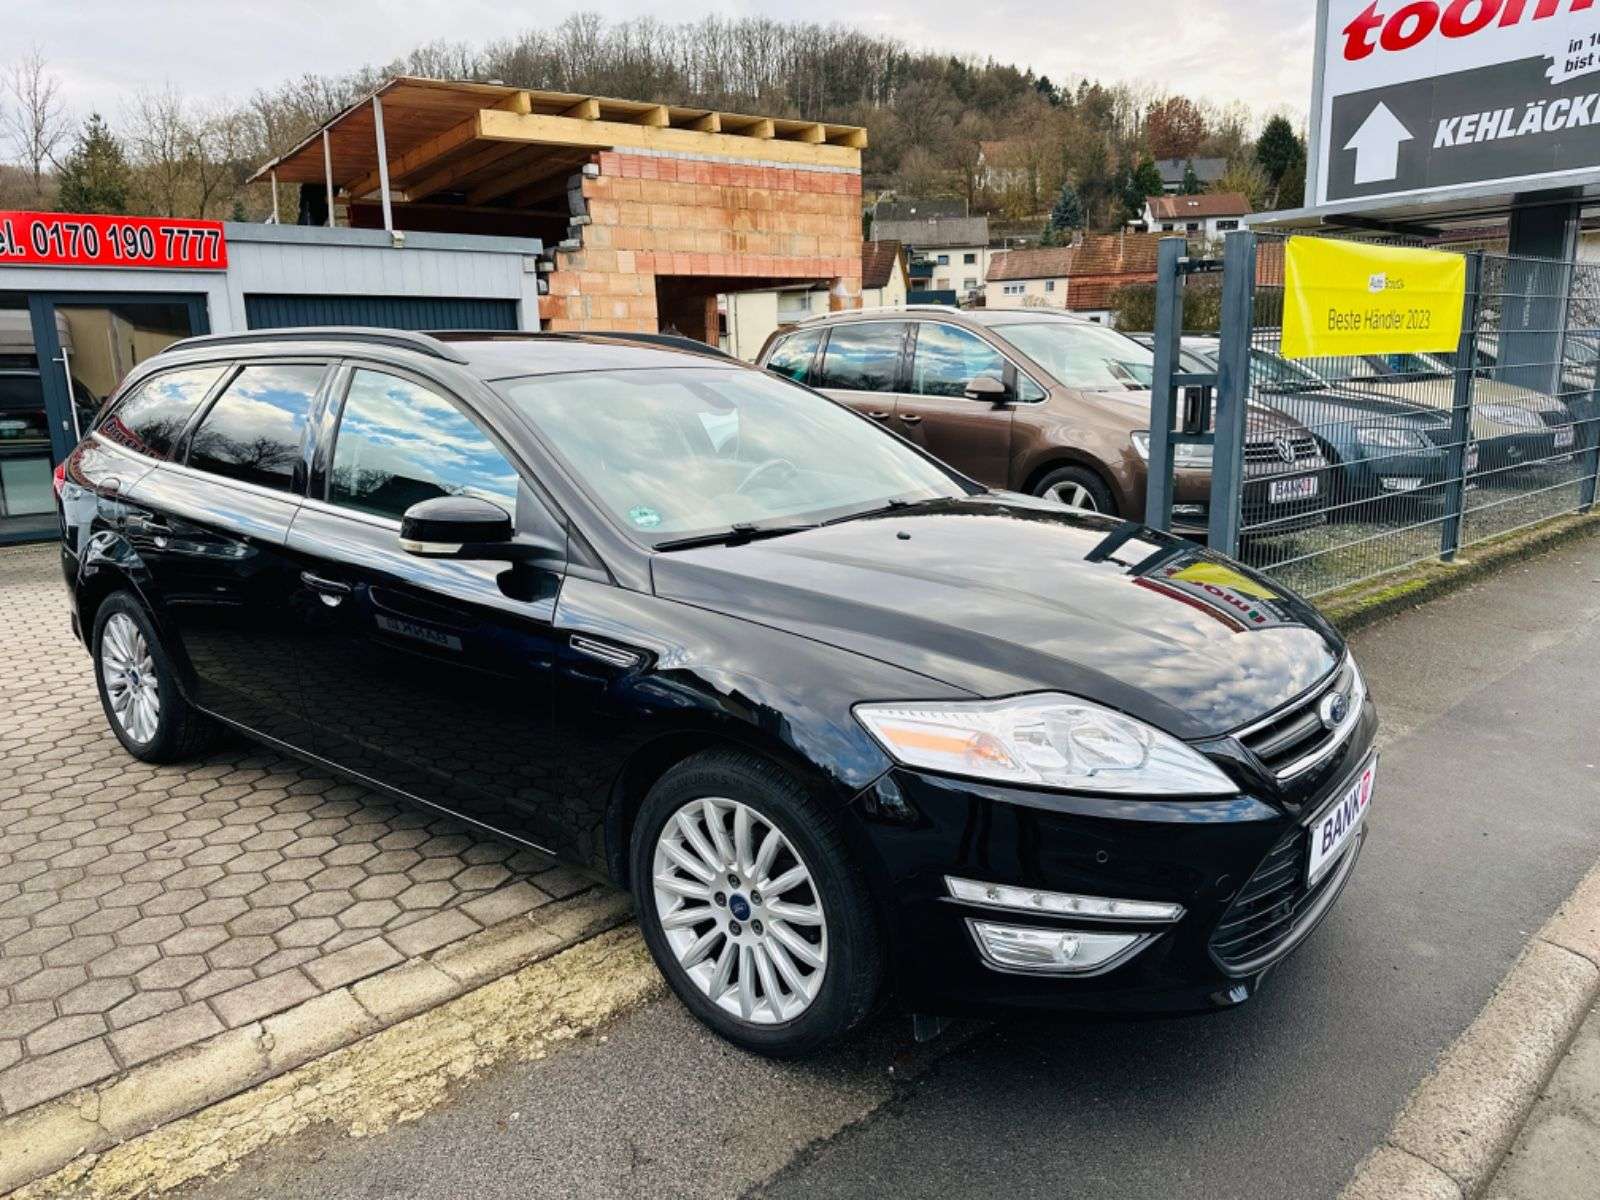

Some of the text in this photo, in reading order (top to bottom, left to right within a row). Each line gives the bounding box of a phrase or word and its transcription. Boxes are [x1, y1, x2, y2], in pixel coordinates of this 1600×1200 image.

[1568, 39, 1583, 53] in
[1564, 52, 1594, 73] bist
[31, 220, 99, 257] 0170
[106, 224, 155, 259] 190
[161, 228, 220, 261] 7777
[1327, 308, 1431, 330] Beste Händler 2023
[1321, 783, 1361, 855] BANK
